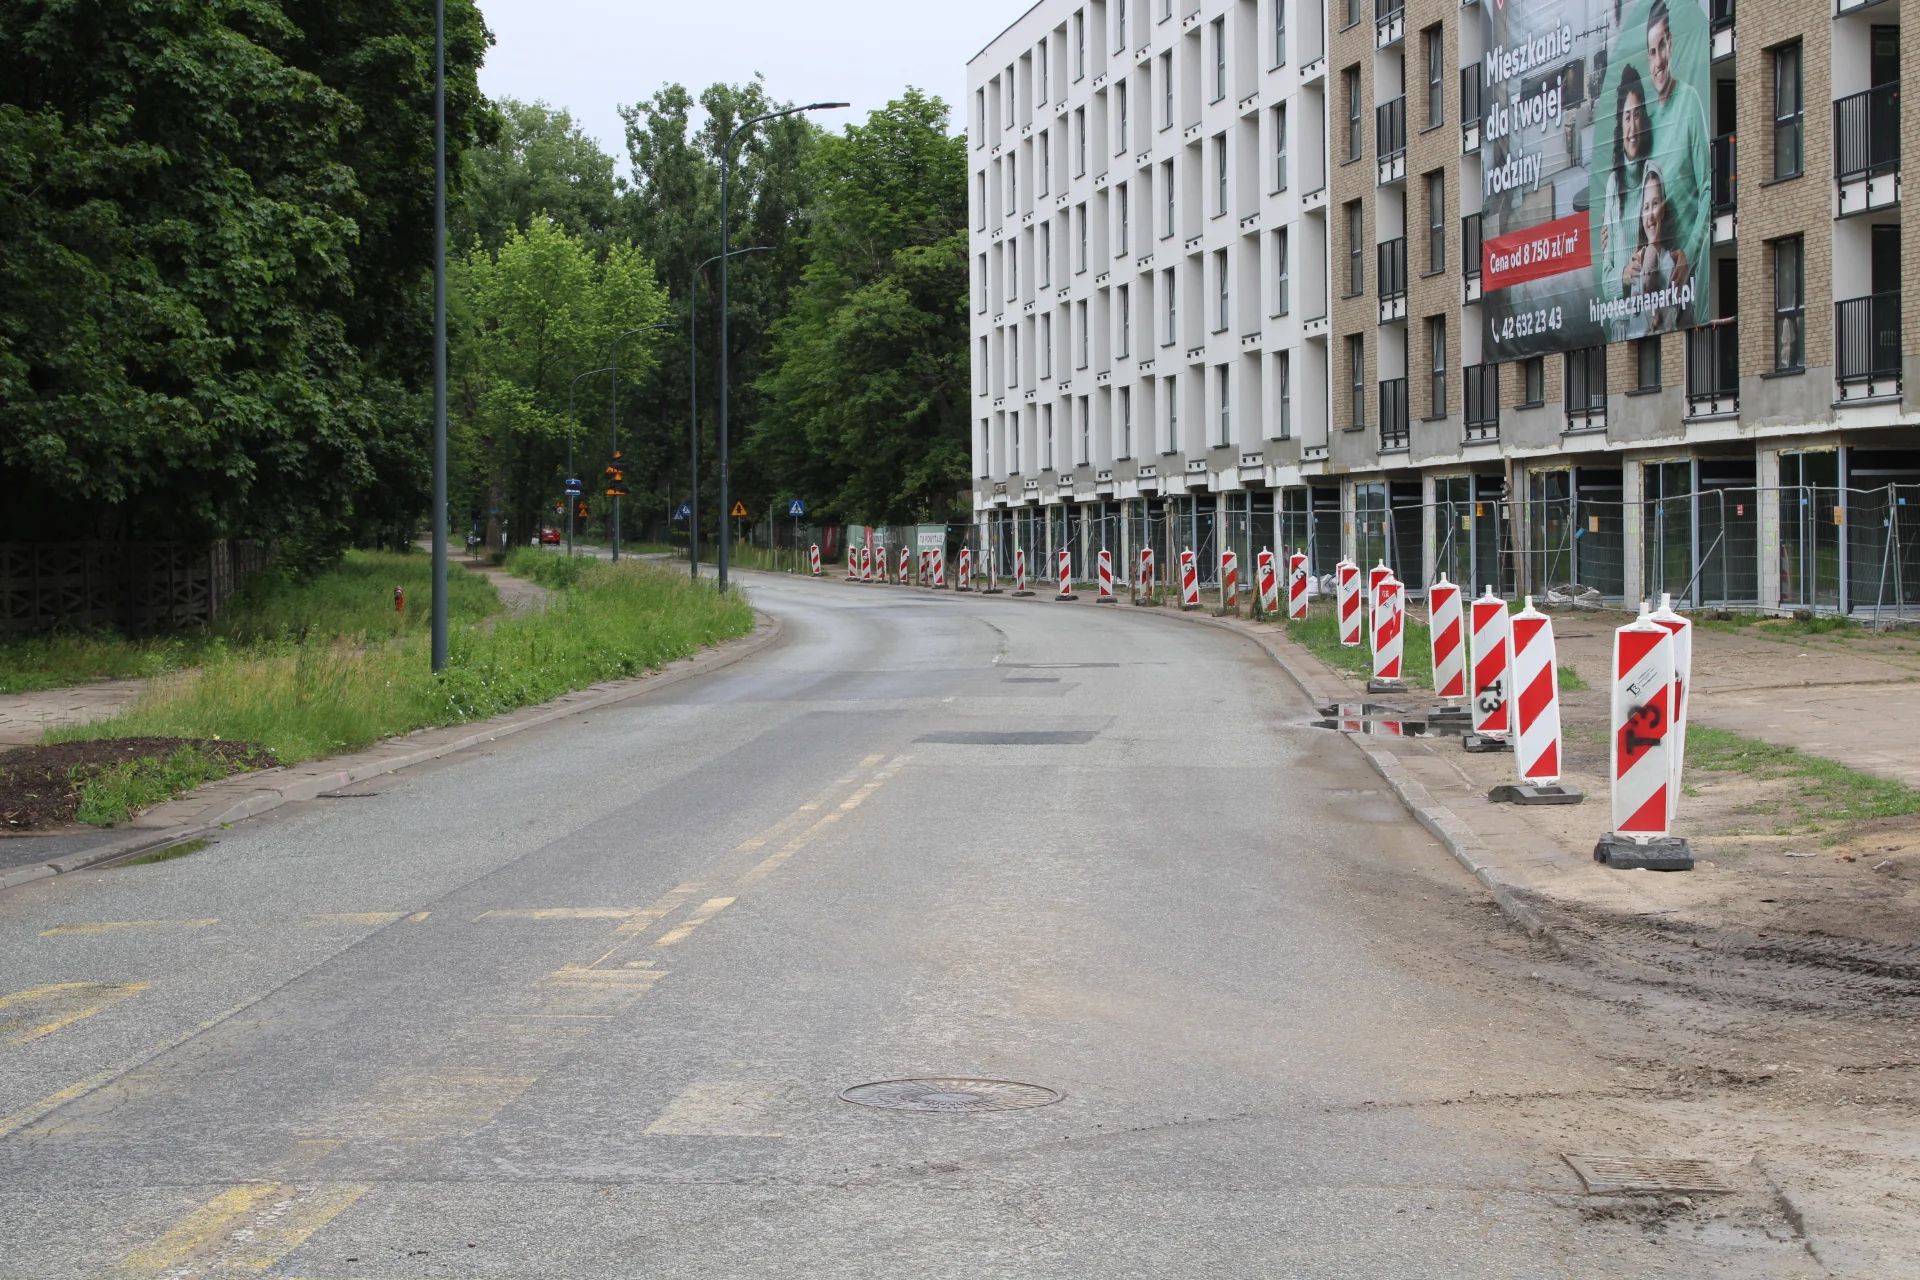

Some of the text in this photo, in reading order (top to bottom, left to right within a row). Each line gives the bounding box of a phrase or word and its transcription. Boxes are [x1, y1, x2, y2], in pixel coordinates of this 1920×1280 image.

[1486, 18, 1572, 87] Mieszkanie
[1486, 75, 1562, 141] dla Twojej
[1487, 150, 1542, 195] rodziny
[1490, 253, 1509, 274] Cena
[1510, 246, 1522, 268] od
[1523, 244, 1530, 265] 8
[1531, 238, 1550, 262] 750
[1501, 306, 1562, 340] 42 632 23 43
[1589, 276, 1695, 327] hipotecznapark.pl
[1479, 680, 1502, 713] T3
[1625, 704, 1661, 756] T3
